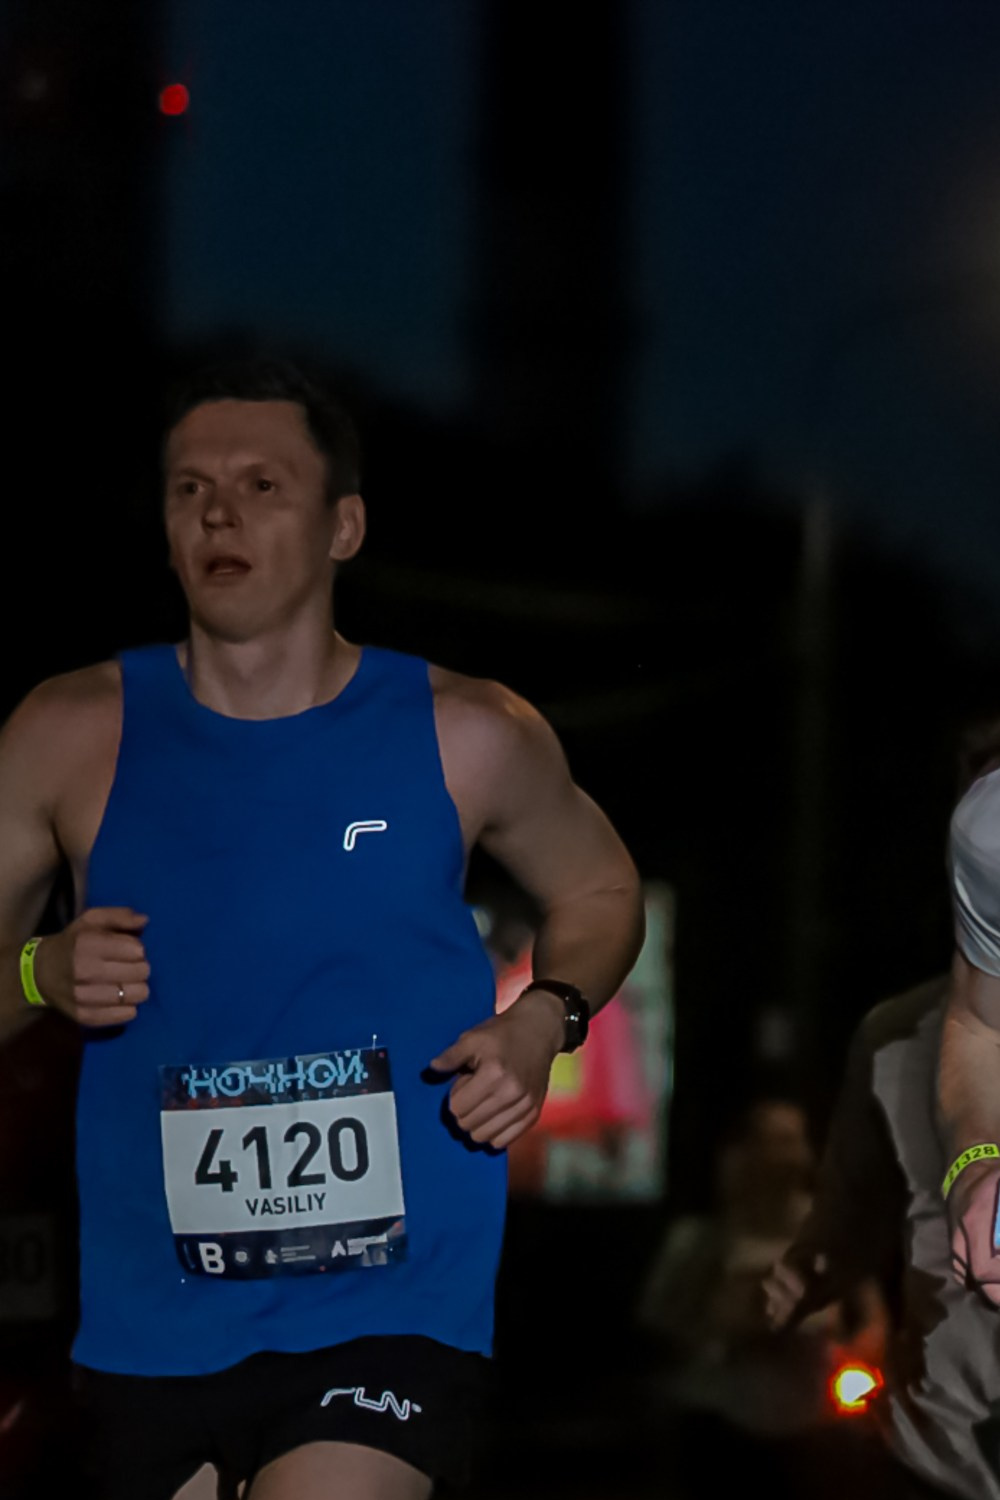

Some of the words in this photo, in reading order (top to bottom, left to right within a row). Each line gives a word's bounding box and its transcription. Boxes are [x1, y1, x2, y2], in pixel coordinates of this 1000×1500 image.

[194, 1117, 370, 1193] 4120
[245, 1193, 327, 1216] VASILIY
[198, 1241, 226, 1274] B
